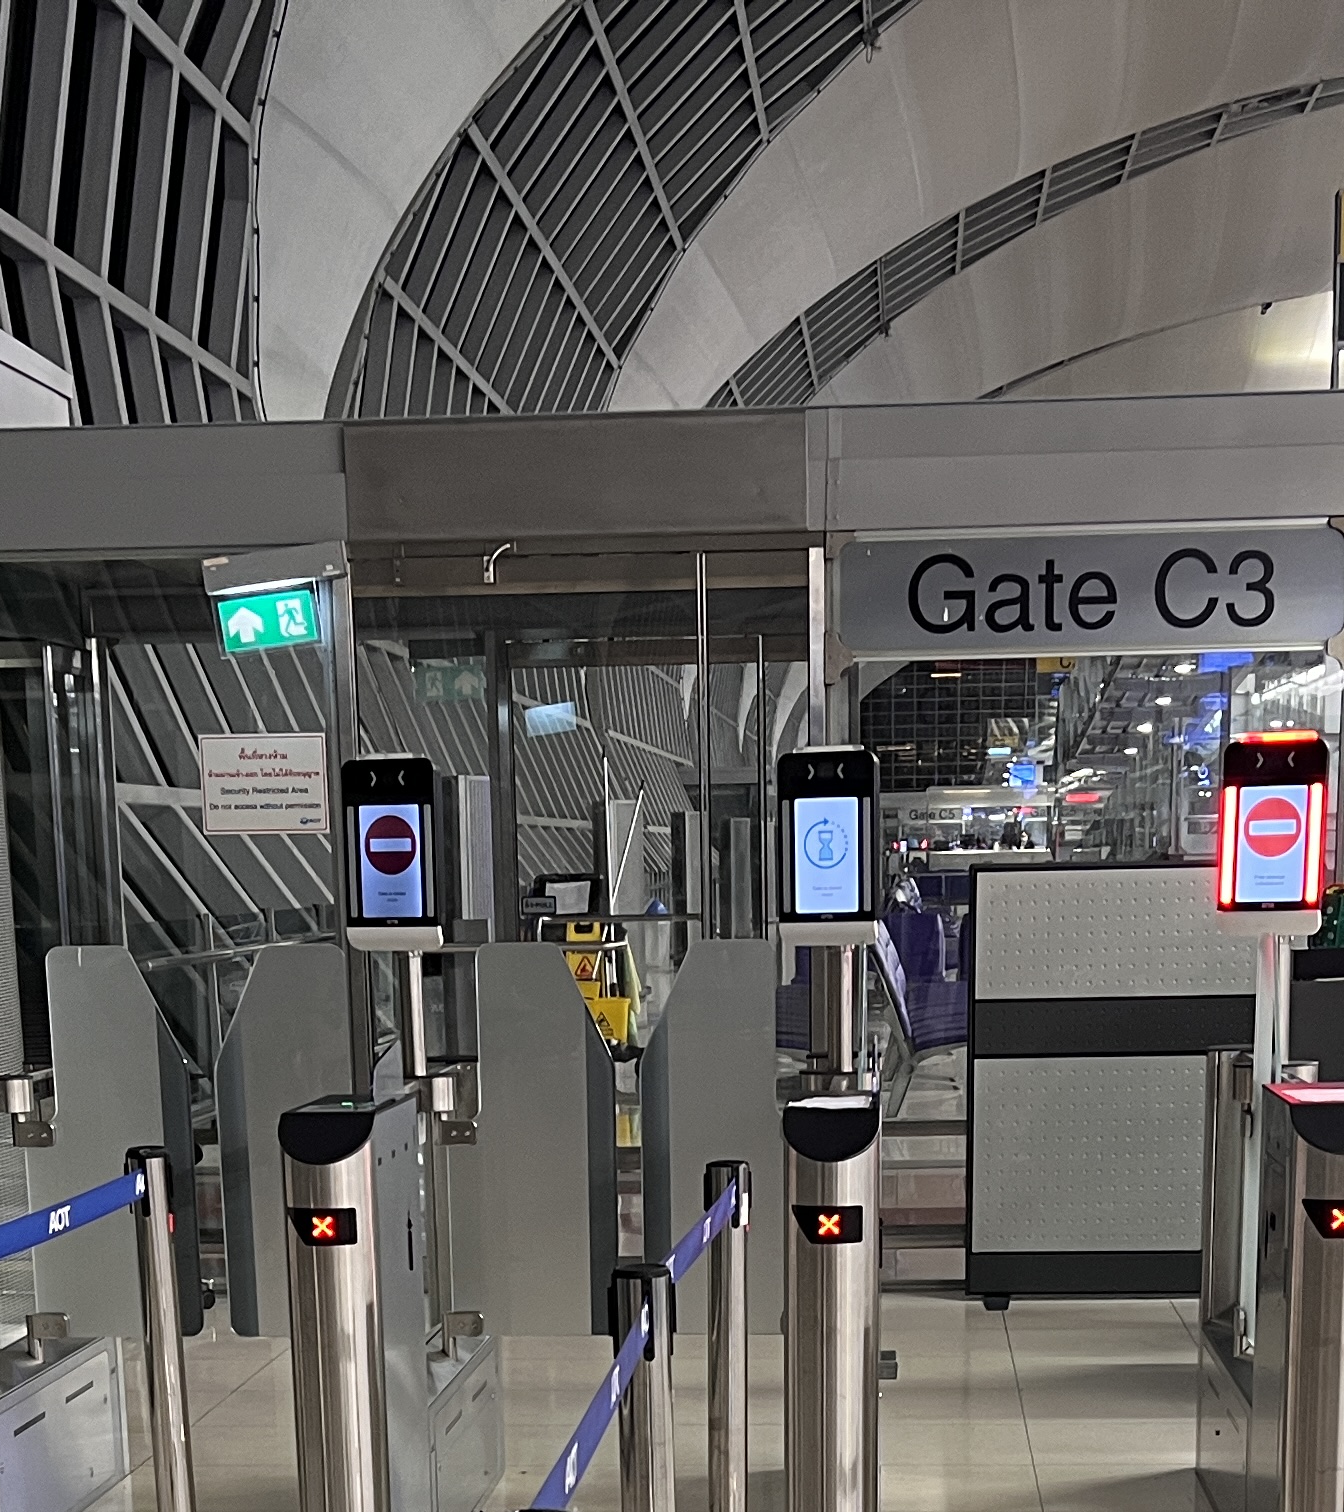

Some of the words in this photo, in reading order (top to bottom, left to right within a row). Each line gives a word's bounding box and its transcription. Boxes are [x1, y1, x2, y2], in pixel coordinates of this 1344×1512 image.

[908, 553, 1118, 634] Gate
[1154, 548, 1276, 628] C3
[291, 785, 309, 794] Area
[48, 1205, 71, 1234] AOT
